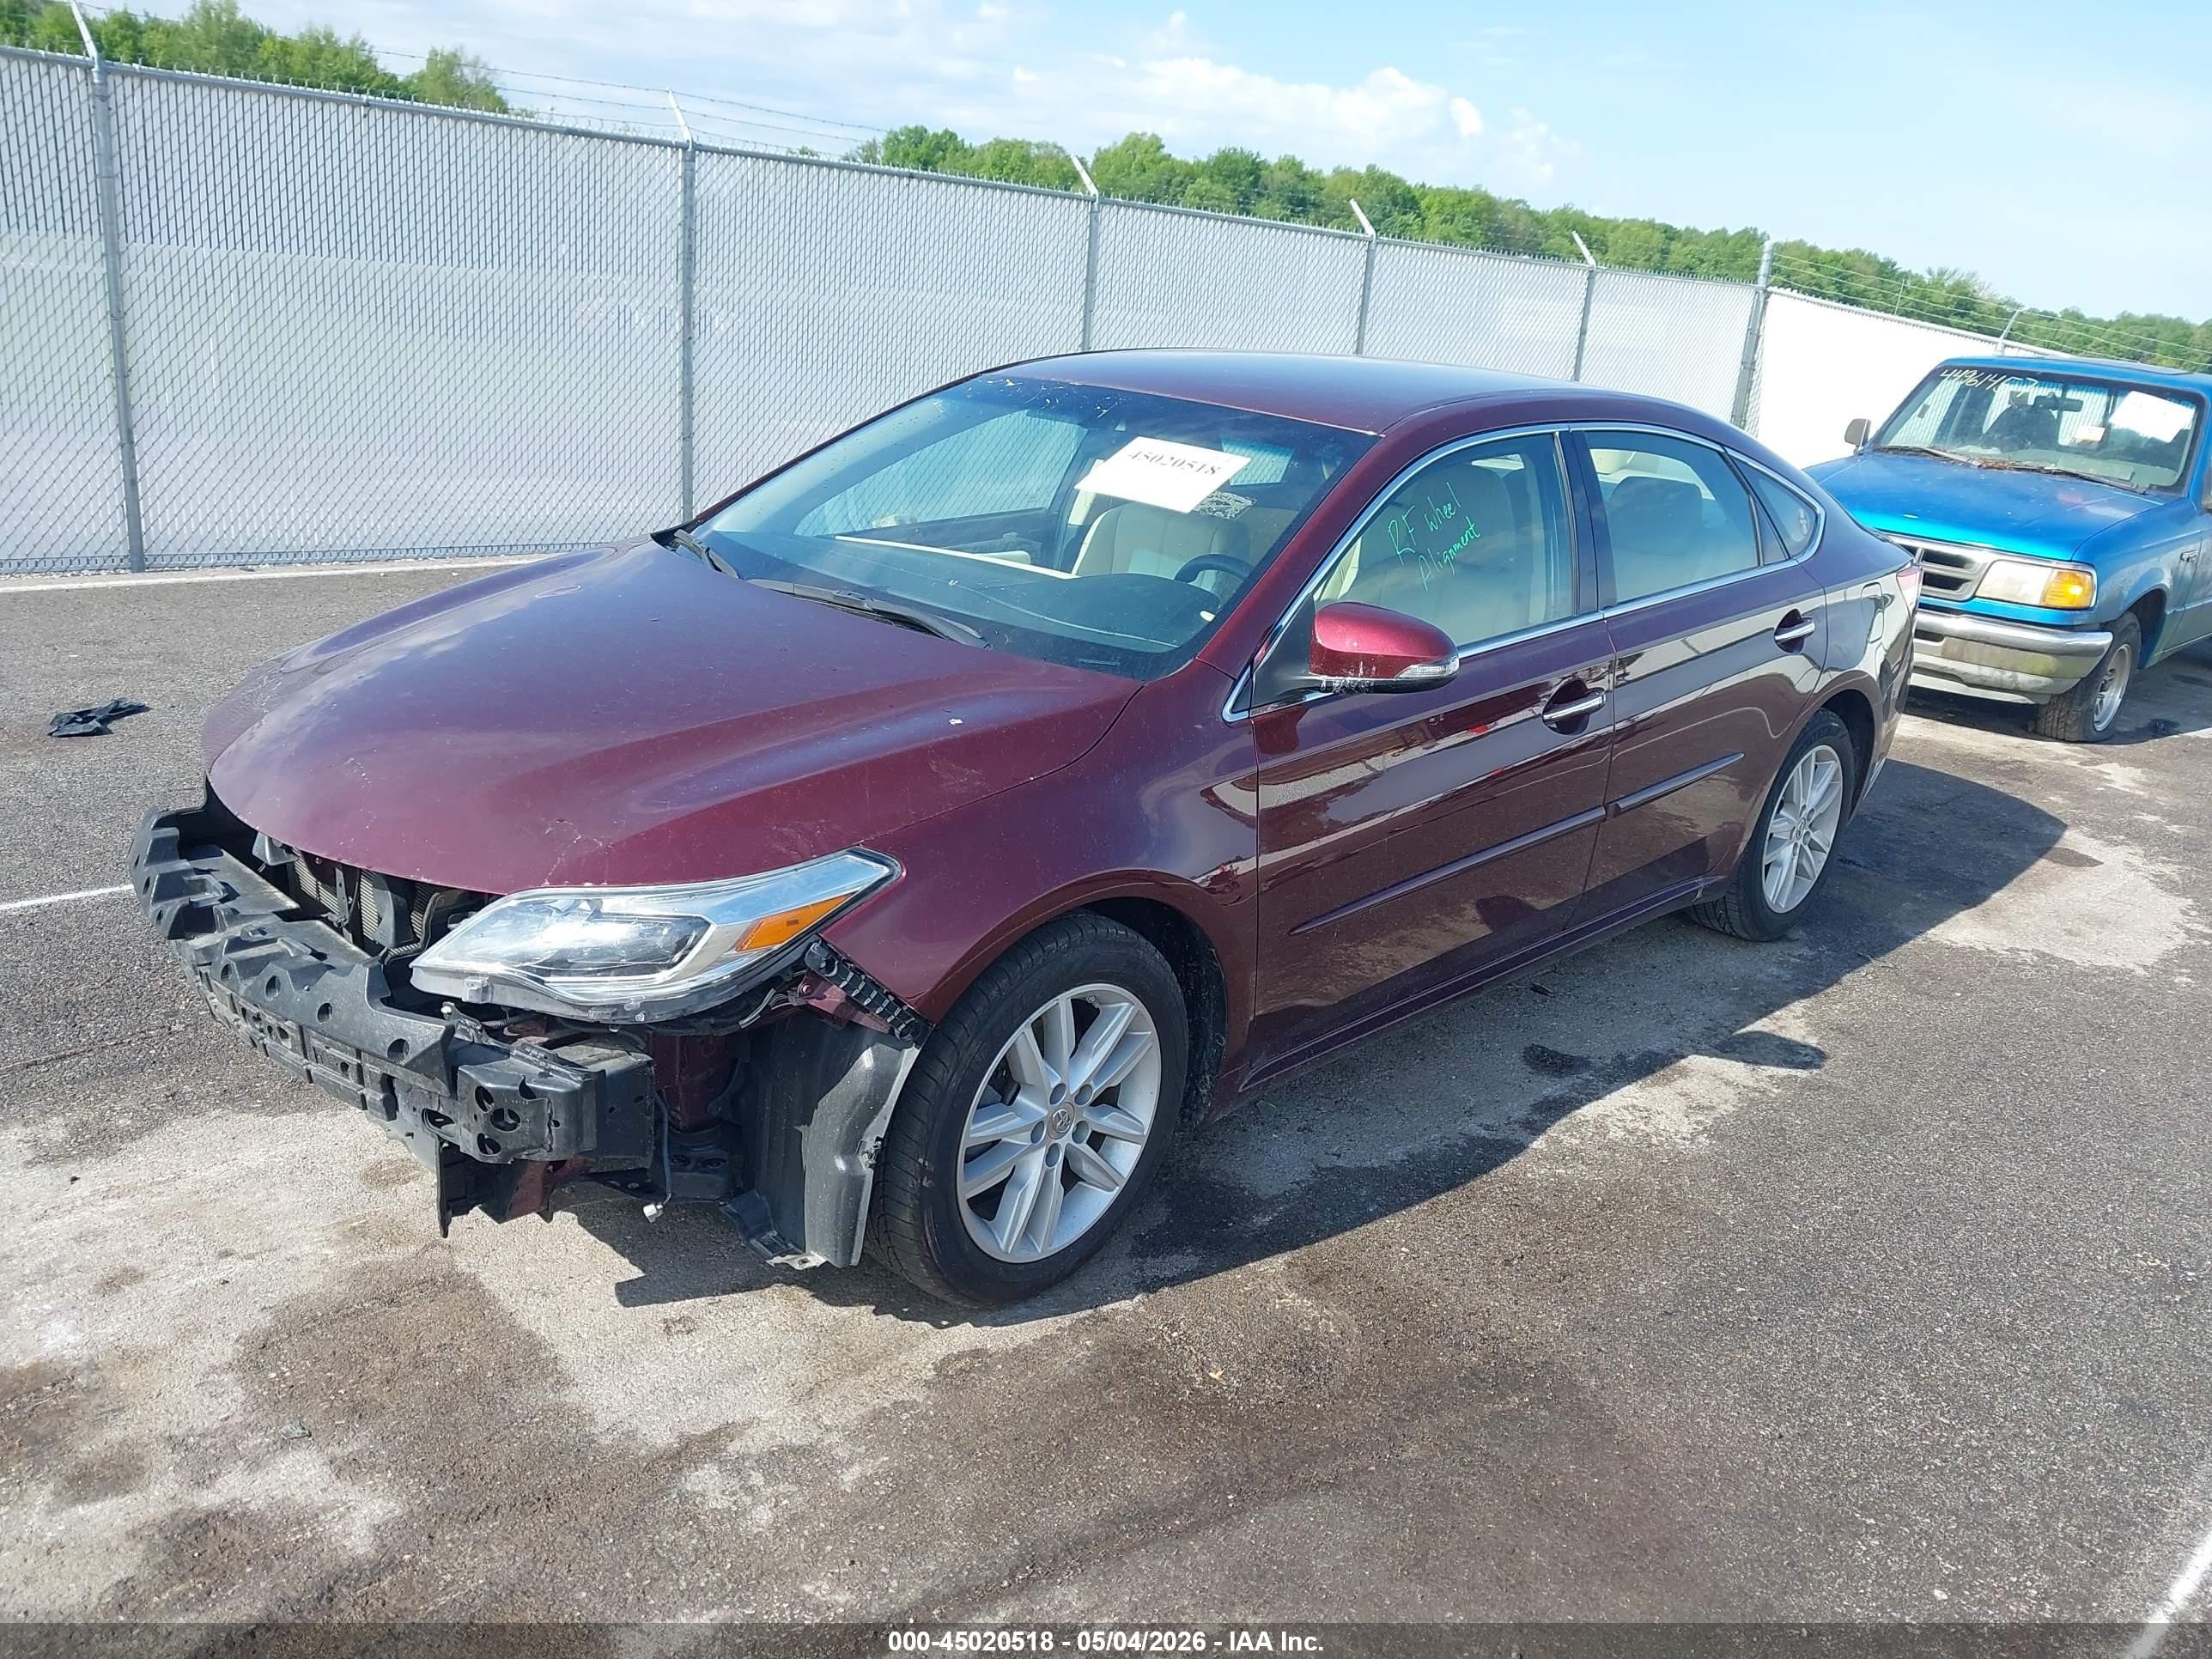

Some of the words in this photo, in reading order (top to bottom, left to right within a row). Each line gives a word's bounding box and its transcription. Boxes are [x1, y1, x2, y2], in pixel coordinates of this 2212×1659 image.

[1128, 451, 1221, 475] 45020518
[1388, 505, 1417, 567] RF
[1416, 515, 1481, 592] Alignment
